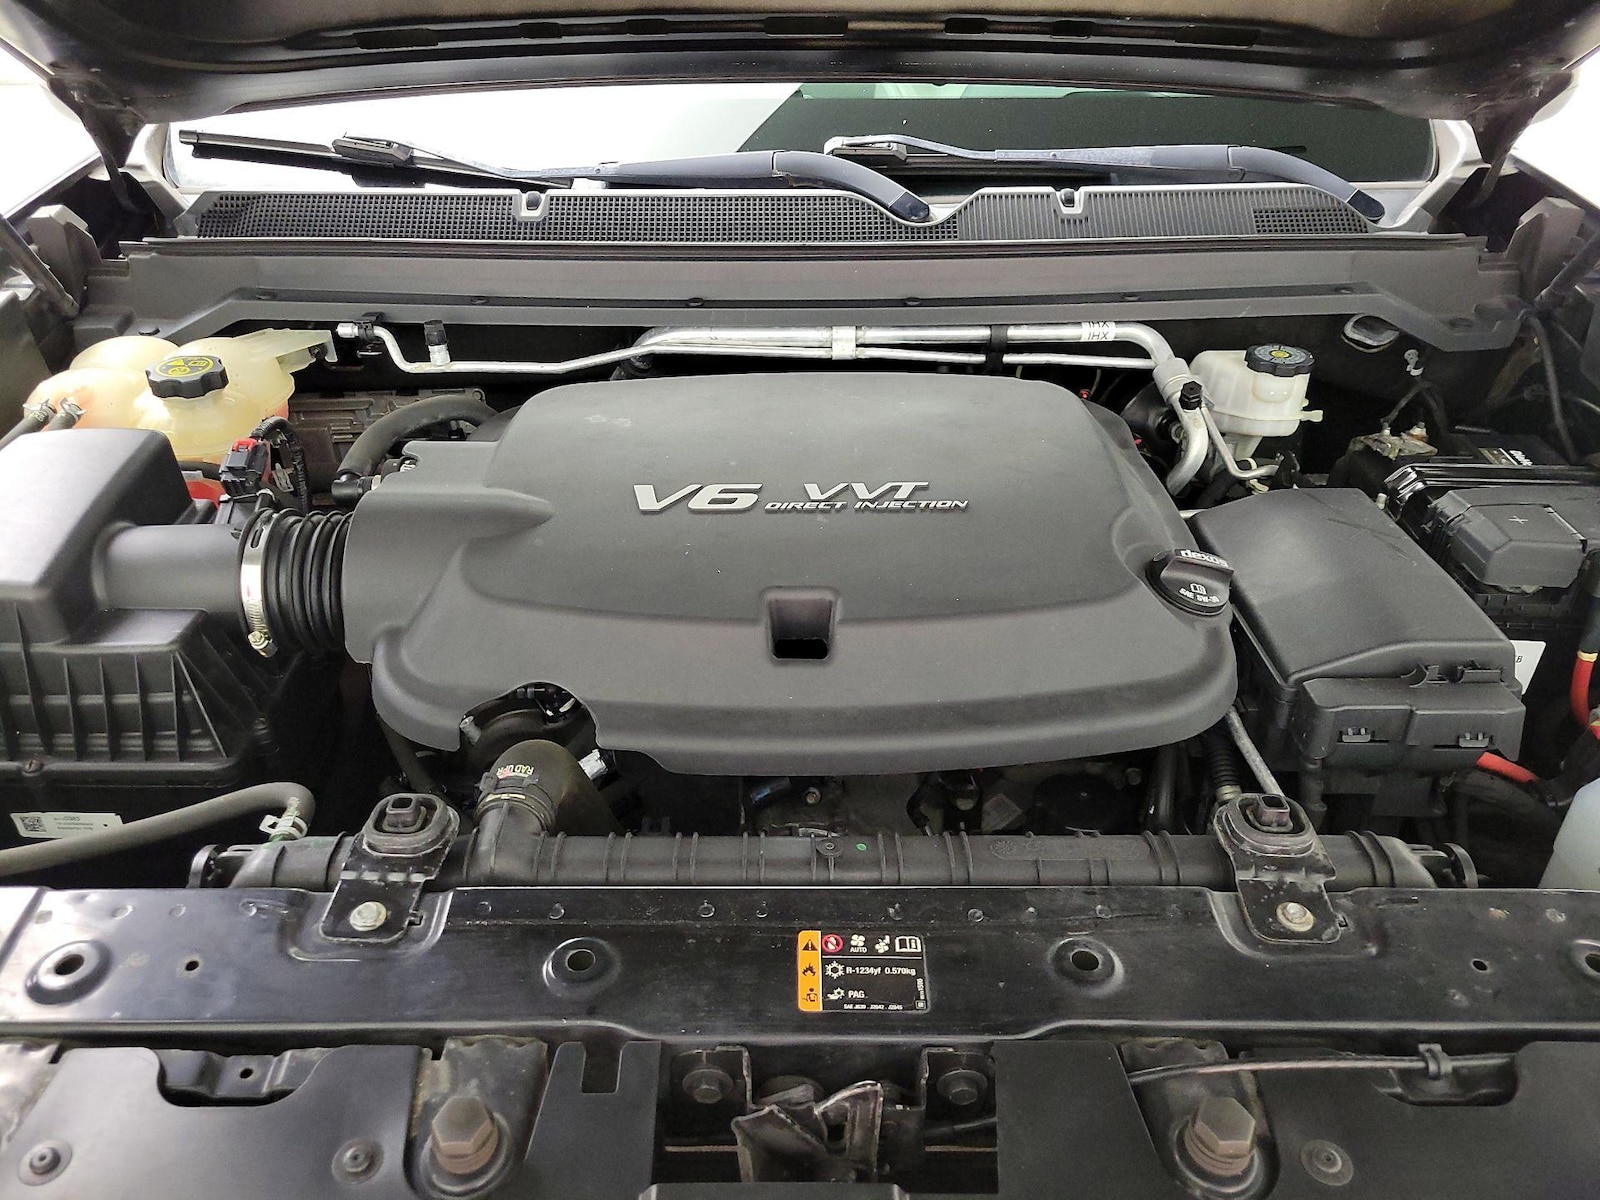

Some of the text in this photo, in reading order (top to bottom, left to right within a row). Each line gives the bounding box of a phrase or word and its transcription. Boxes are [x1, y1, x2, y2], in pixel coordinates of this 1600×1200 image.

[633, 481, 929, 513] V6 VVT
[764, 500, 969, 511] DIRECT INJECTION
[1180, 550, 1229, 568] dexos
[515, 765, 535, 775] RAD
[845, 967, 917, 976] R-1234yf 0.570kg
[848, 990, 865, 998] PAG
